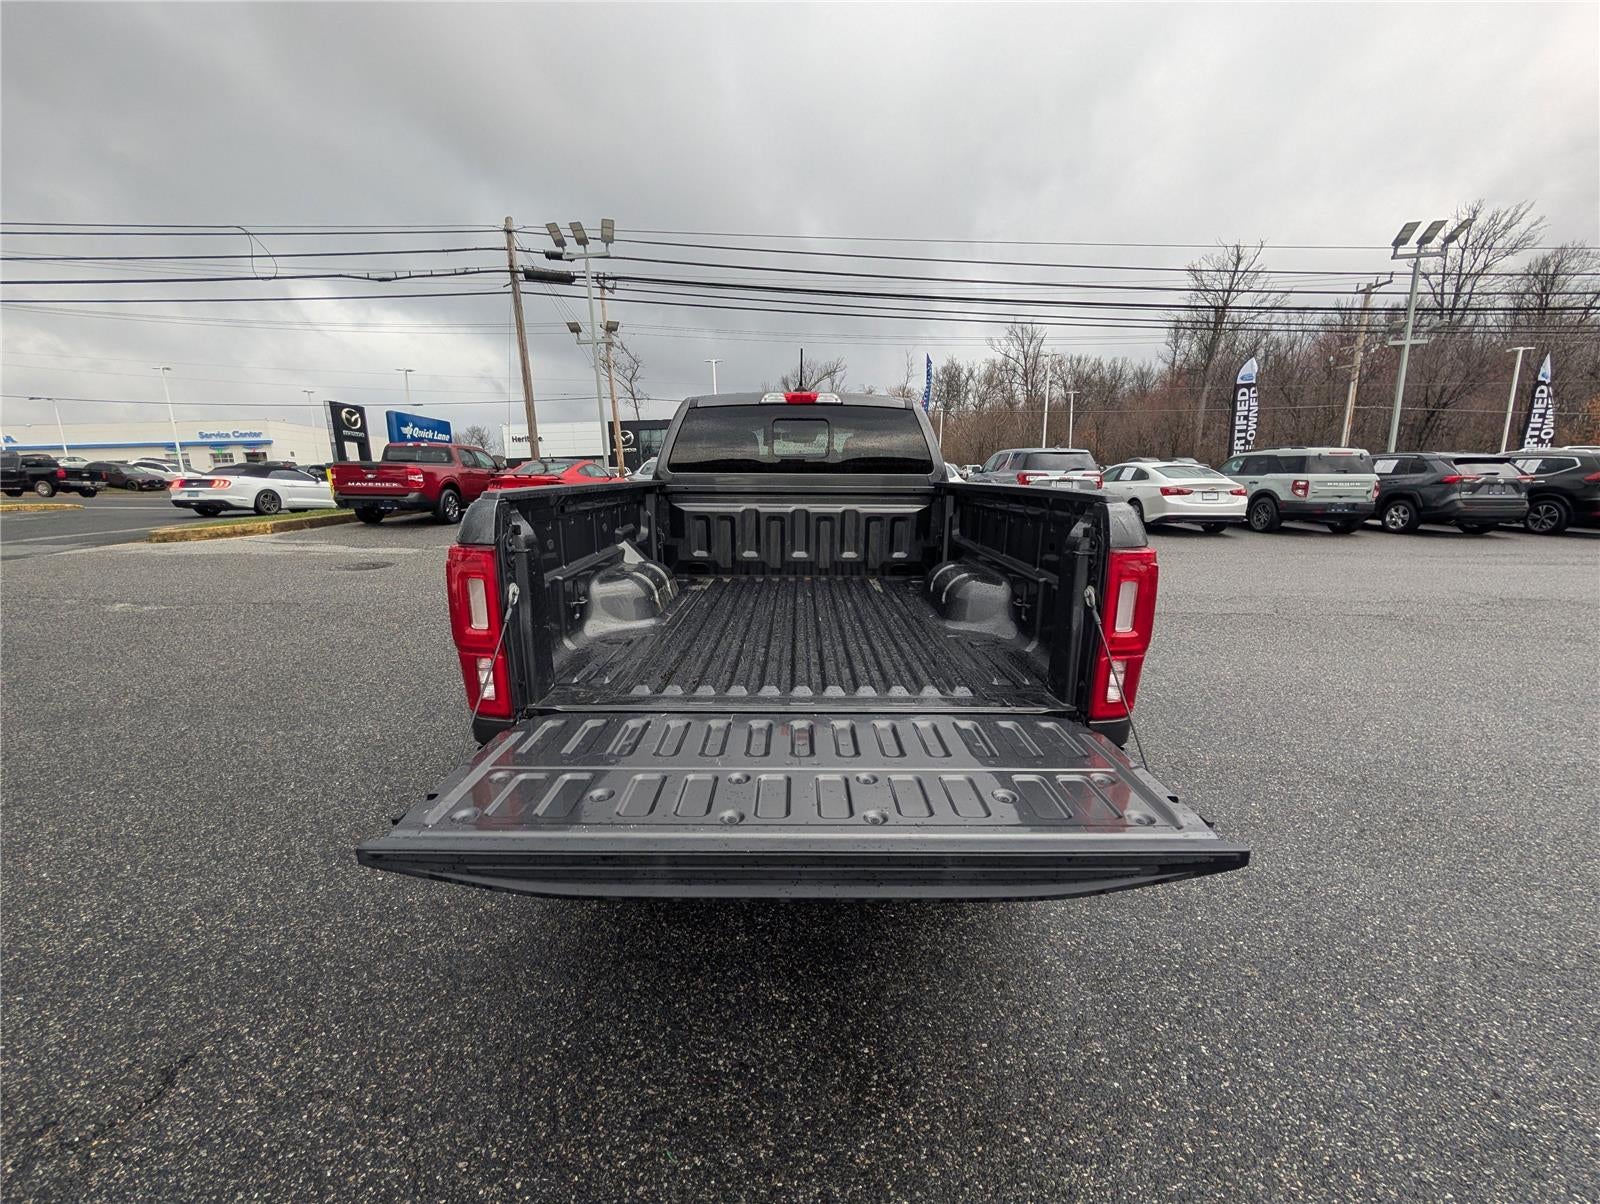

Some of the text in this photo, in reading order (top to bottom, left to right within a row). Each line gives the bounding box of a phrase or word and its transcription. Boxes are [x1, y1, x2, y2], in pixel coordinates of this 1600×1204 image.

[1524, 385, 1548, 448] RTIFIED
[198, 431, 231, 439] Service
[412, 427, 450, 441] Quick Lane
